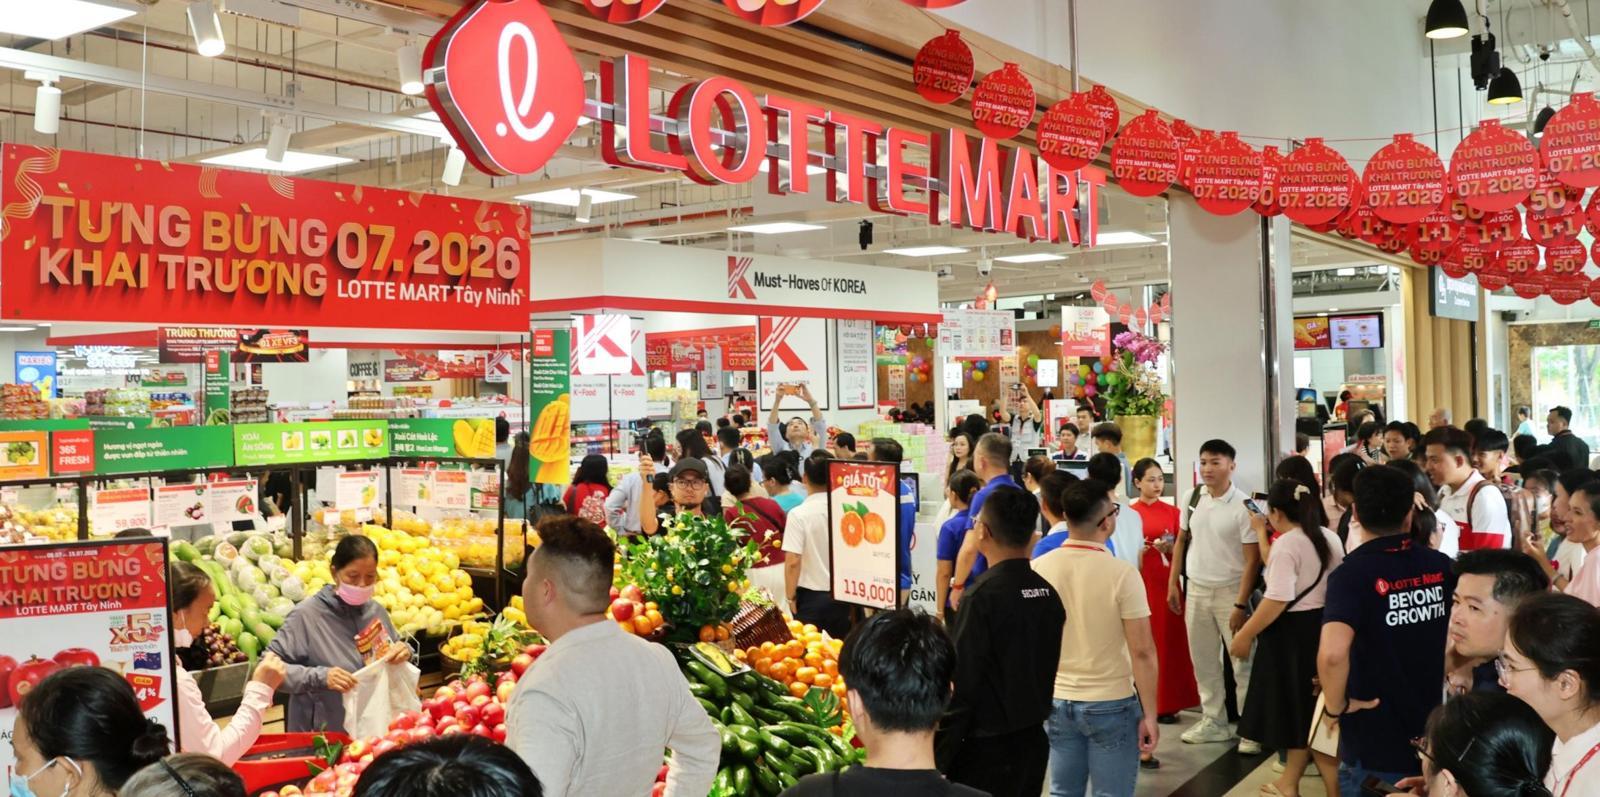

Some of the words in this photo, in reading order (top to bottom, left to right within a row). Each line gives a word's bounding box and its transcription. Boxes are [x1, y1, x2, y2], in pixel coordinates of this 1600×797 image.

[992, 103, 1007, 111] MART
[993, 111, 1029, 128] 2026
[1041, 131, 1059, 139] LOTTE
[1548, 136, 1576, 147] KHAI
[610, 54, 930, 214] LOTTE
[945, 127, 1105, 247] MART
[1060, 143, 1098, 160] 2026
[1548, 149, 1574, 157] LOTTE
[1574, 146, 1595, 154] MART
[1138, 167, 1177, 182] 2026
[1456, 162, 1483, 171] KHAI
[1369, 173, 1394, 182] KHAI
[1457, 174, 1479, 182] LOTTE
[1480, 170, 1501, 178] MART
[1218, 185, 1260, 200] 2026
[1368, 184, 1391, 192] LOTTE
[1458, 181, 1485, 196] 07.
[1488, 174, 1536, 193] 2026
[1305, 192, 1349, 207] 2026
[1369, 192, 1394, 207] 07.
[1397, 189, 1443, 206] 2026
[41, 196, 191, 248] TƯNG
[203, 203, 328, 258] BỪNG
[1418, 223, 1453, 242] 1+1
[1479, 223, 1514, 243] 1+1
[1540, 217, 1578, 239] 1+1
[412, 230, 520, 279] 2026
[39, 247, 149, 290] KHAI
[159, 255, 328, 298] TRƯƠNG
[754, 272, 820, 291] Must-Haves
[821, 277, 832, 291] Of
[834, 278, 867, 294] KOREA
[337, 279, 396, 300] LOTTE
[400, 282, 451, 303] MART
[453, 284, 483, 307] Tây
[486, 287, 520, 306] Ninh
[350, 362, 372, 377] COFFEE
[59, 445, 77, 455] 365
[59, 456, 90, 465] FRESH
[843, 469, 860, 489] GIÁ
[861, 472, 882, 490] TỐT
[0, 561, 68, 584] TƯNG
[73, 556, 141, 580] BỪNG
[844, 579, 895, 603] 119,000
[1389, 577, 1422, 590] LOTTE
[0, 587, 48, 606] KHAI
[52, 581, 142, 602] TRƯƠNG
[910, 587, 936, 602] GÂN
[1022, 588, 1050, 598] SECURITY
[1388, 586, 1444, 610] BEYOND
[16, 606, 48, 616] LOTTE
[49, 603, 80, 613] MART
[81, 601, 98, 612] Tây
[100, 600, 123, 610] Ninh
[1385, 602, 1446, 626] GROWTH
